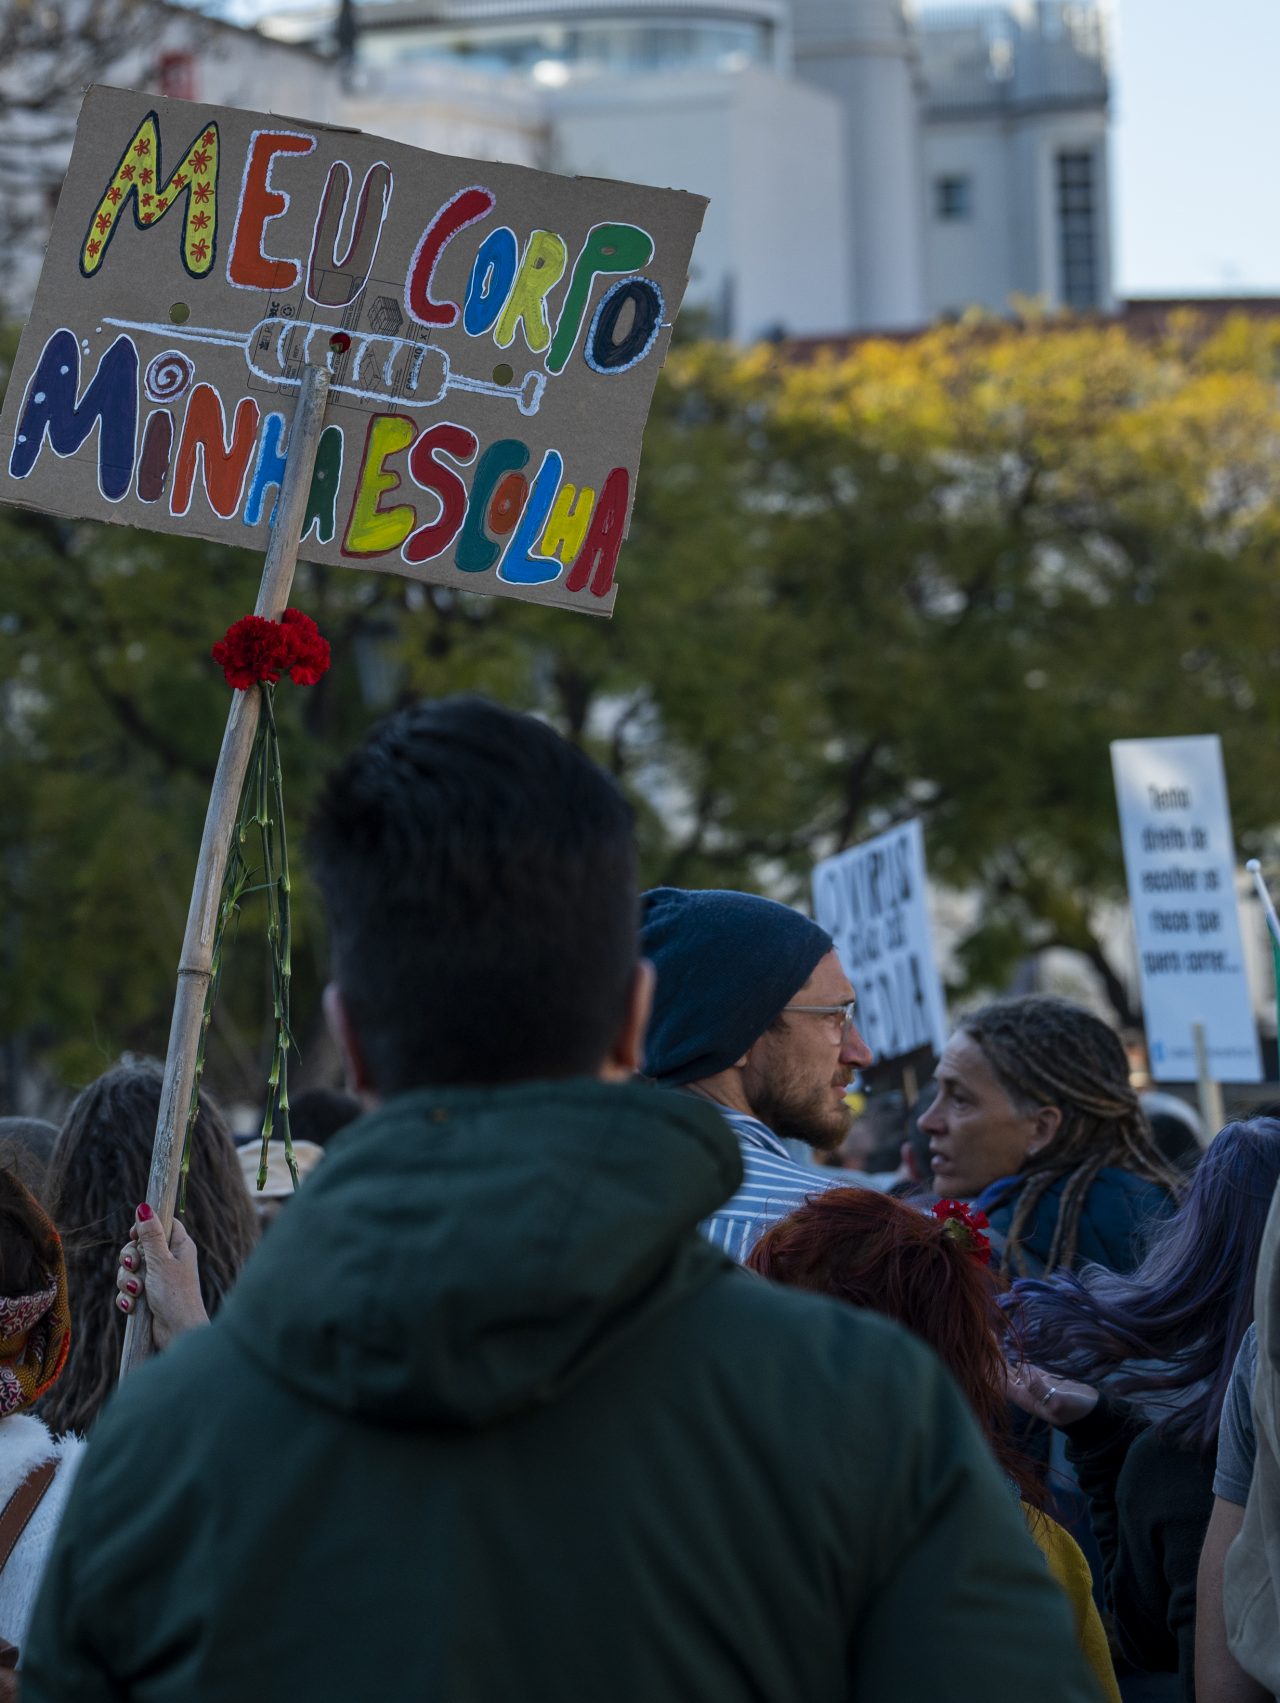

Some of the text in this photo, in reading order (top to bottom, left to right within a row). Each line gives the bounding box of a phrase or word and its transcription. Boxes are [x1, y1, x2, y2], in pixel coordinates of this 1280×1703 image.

[80, 110, 665, 375] MEU CORPO
[341, 413, 630, 597] ESCOLHA
